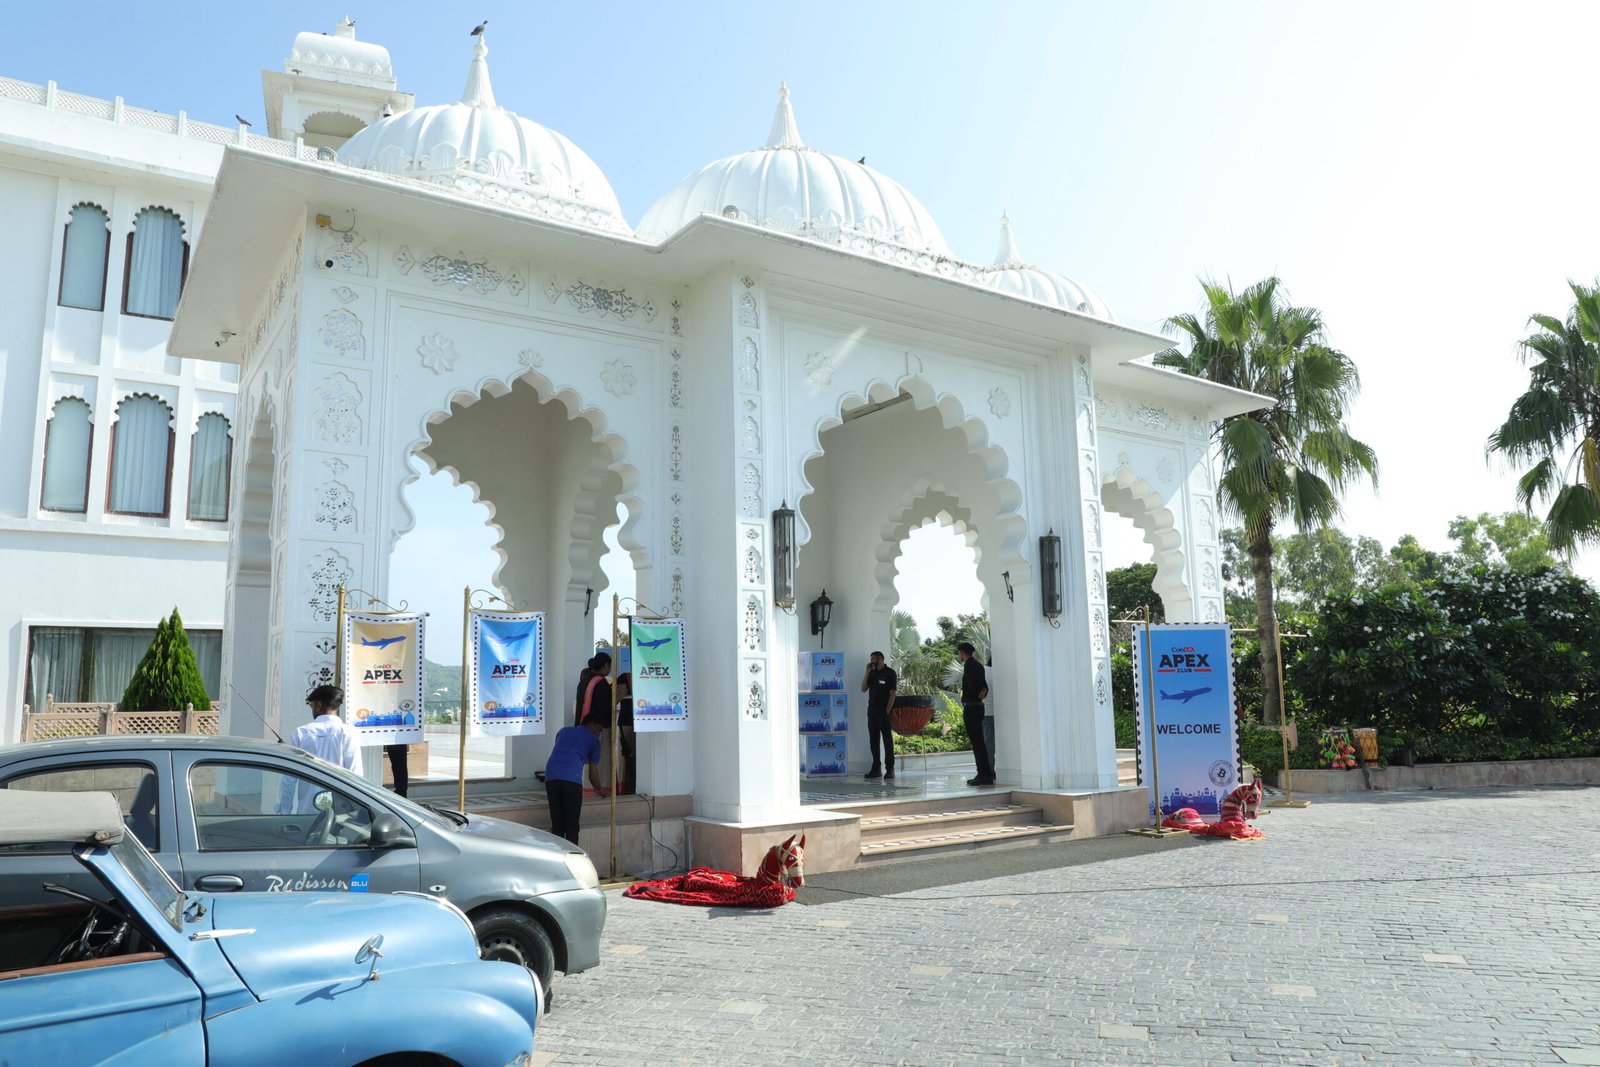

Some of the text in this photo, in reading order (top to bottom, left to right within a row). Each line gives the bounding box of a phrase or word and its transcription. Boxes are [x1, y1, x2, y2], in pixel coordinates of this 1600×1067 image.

[1158, 653, 1211, 668] APEX
[363, 669, 403, 680] APEX
[491, 664, 527, 675] APEX
[639, 666, 671, 676] APEX
[1156, 723, 1222, 735] WELCOME
